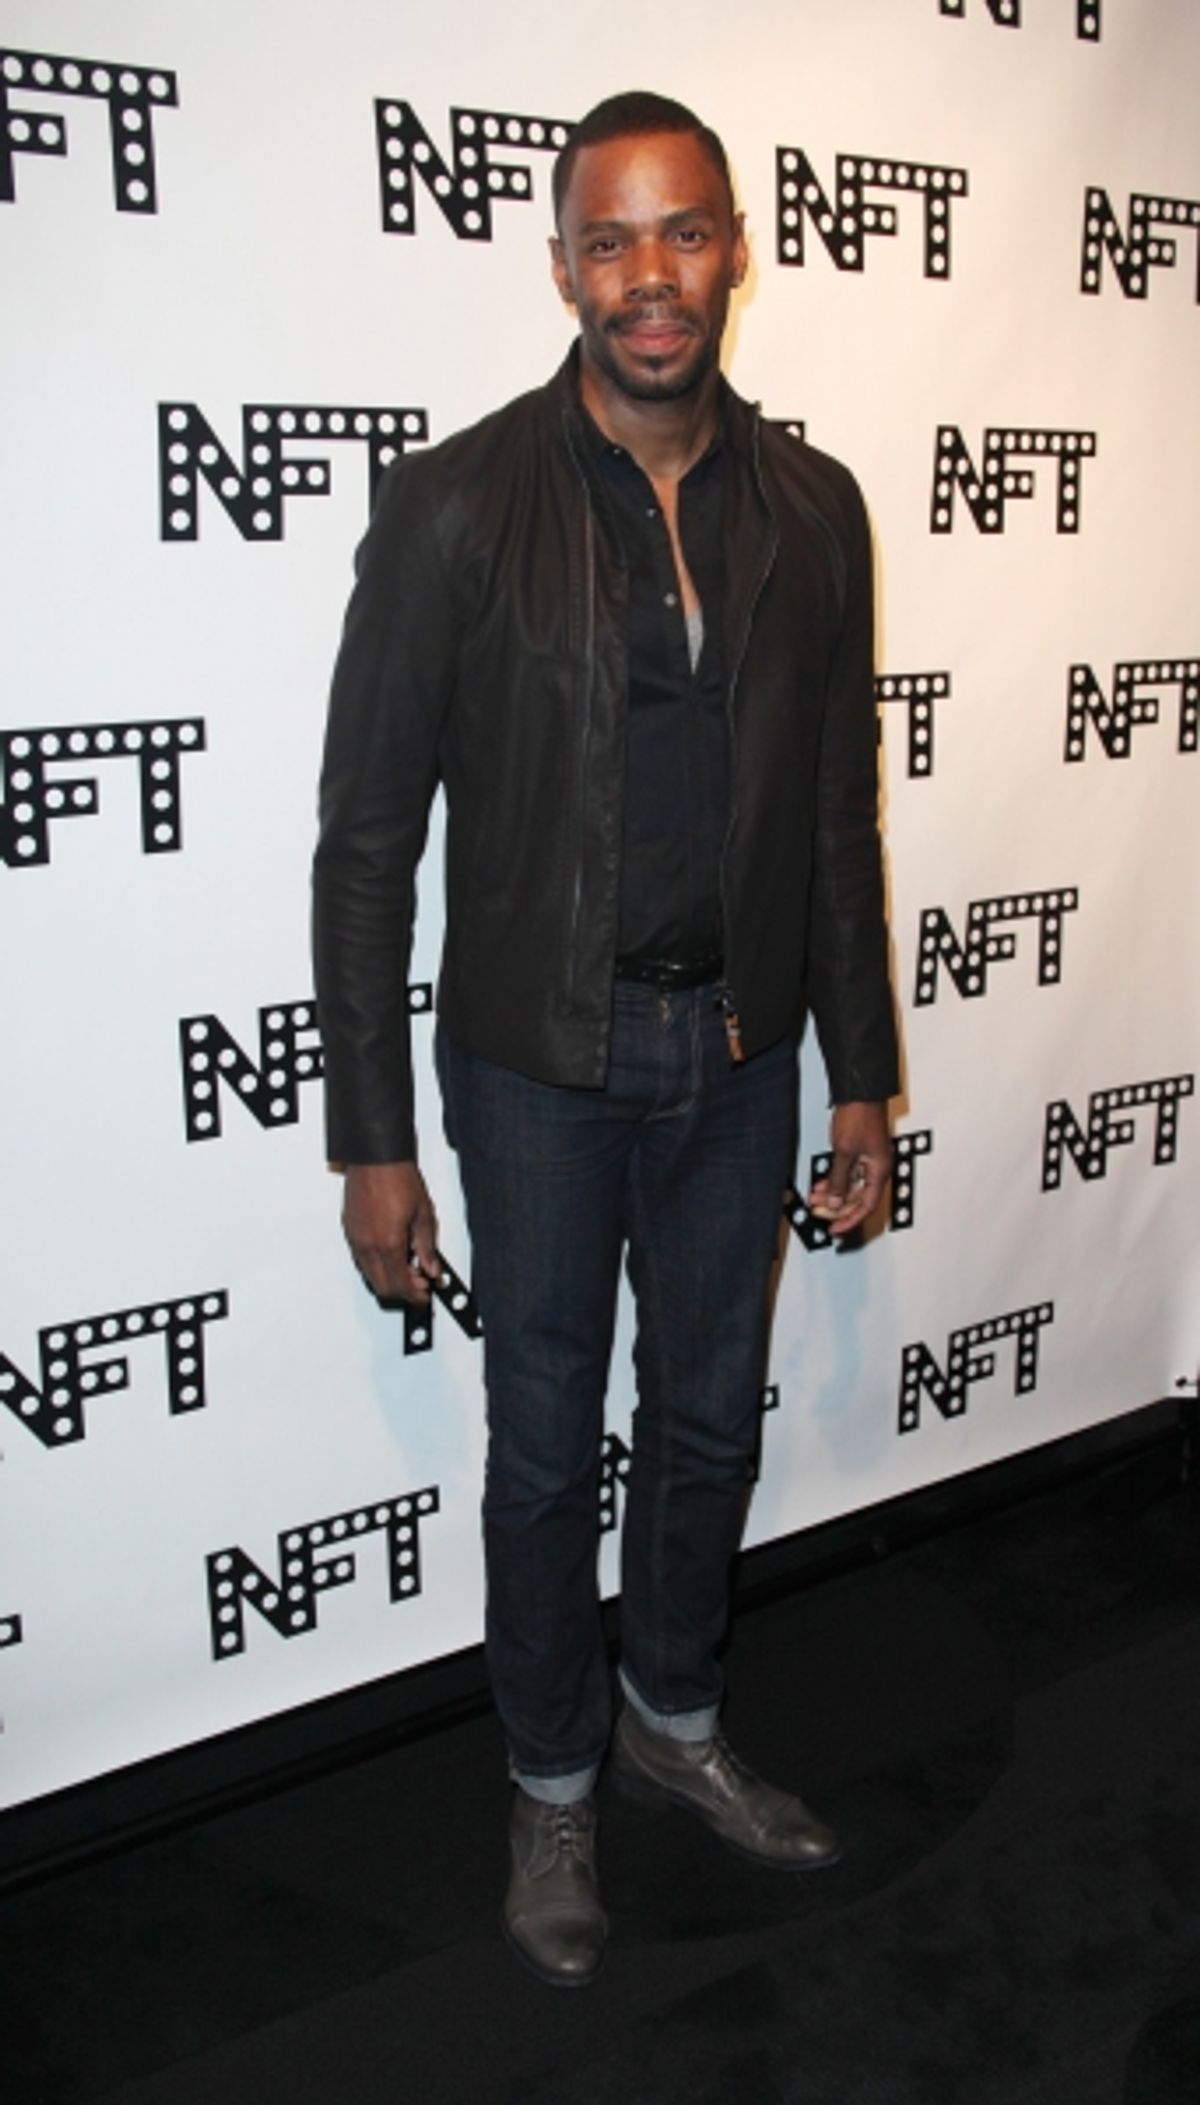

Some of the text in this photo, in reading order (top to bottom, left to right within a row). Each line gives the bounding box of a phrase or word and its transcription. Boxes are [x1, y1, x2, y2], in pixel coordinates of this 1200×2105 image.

[0, 49, 178, 214] FT
[373, 97, 578, 242] NF
[776, 146, 967, 280] NFT
[1080, 186, 1200, 305] NF
[930, 425, 1096, 534] NFT
[1063, 658, 1200, 763] NFT
[913, 887, 1079, 1007] NFT
[1042, 1074, 1194, 1192] NFT
[898, 1300, 1055, 1435] NFT
[206, 1485, 440, 1661] NFT
